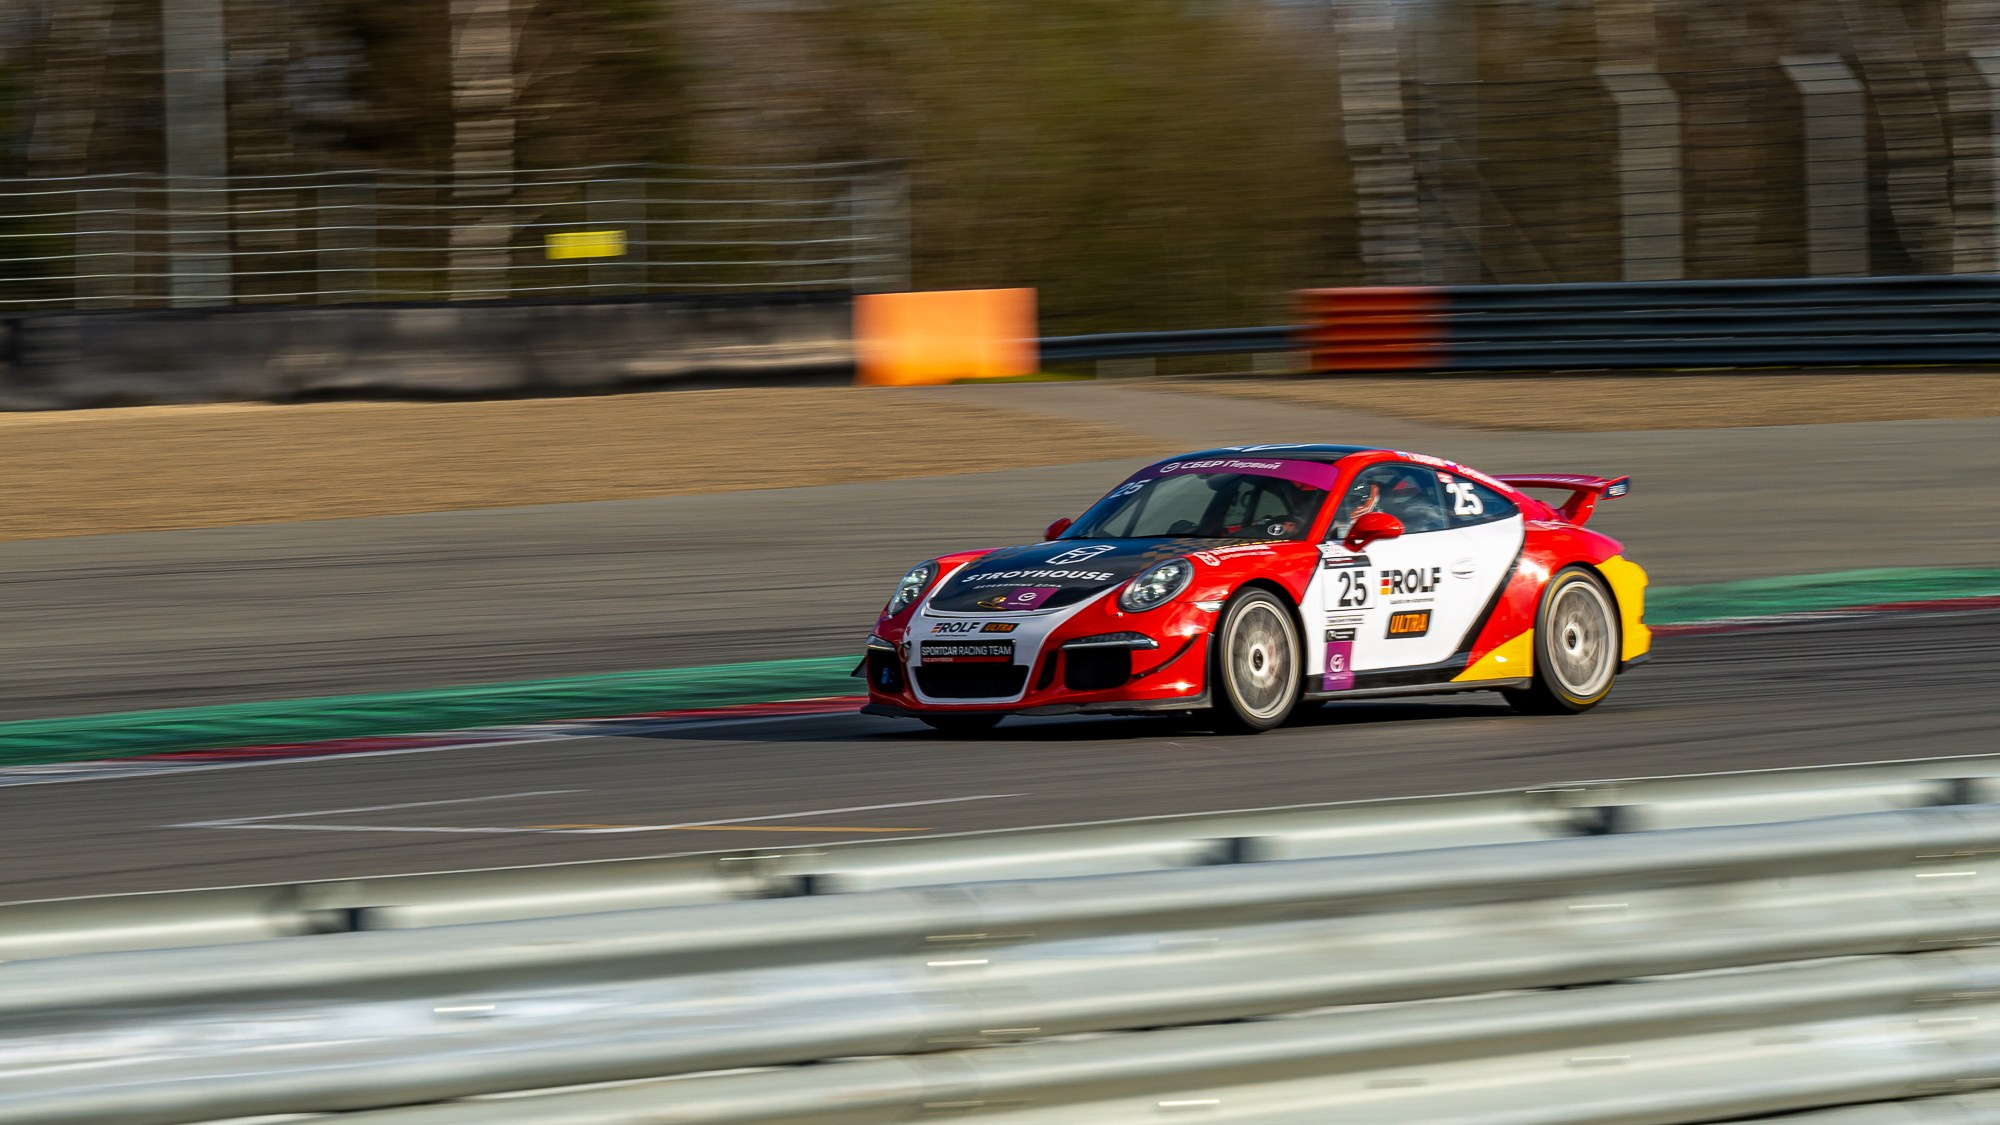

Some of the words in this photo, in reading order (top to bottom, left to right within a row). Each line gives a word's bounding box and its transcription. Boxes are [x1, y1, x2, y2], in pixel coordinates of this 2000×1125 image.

[1180, 460, 1222, 470] СБЕР
[1222, 460, 1283, 470] Первый
[1107, 479, 1152, 499] 25
[1446, 483, 1484, 515] 25
[961, 570, 1114, 583] STROYHOUSE
[1391, 567, 1440, 594] ROLF
[1338, 571, 1368, 607] 25
[937, 622, 980, 633] ROLF
[984, 623, 1014, 632] ULTRA
[1390, 613, 1429, 633] ULTRA
[921, 646, 958, 656] SPORTCAR
[959, 646, 988, 655] RACING
[988, 645, 1012, 655] TEAM
